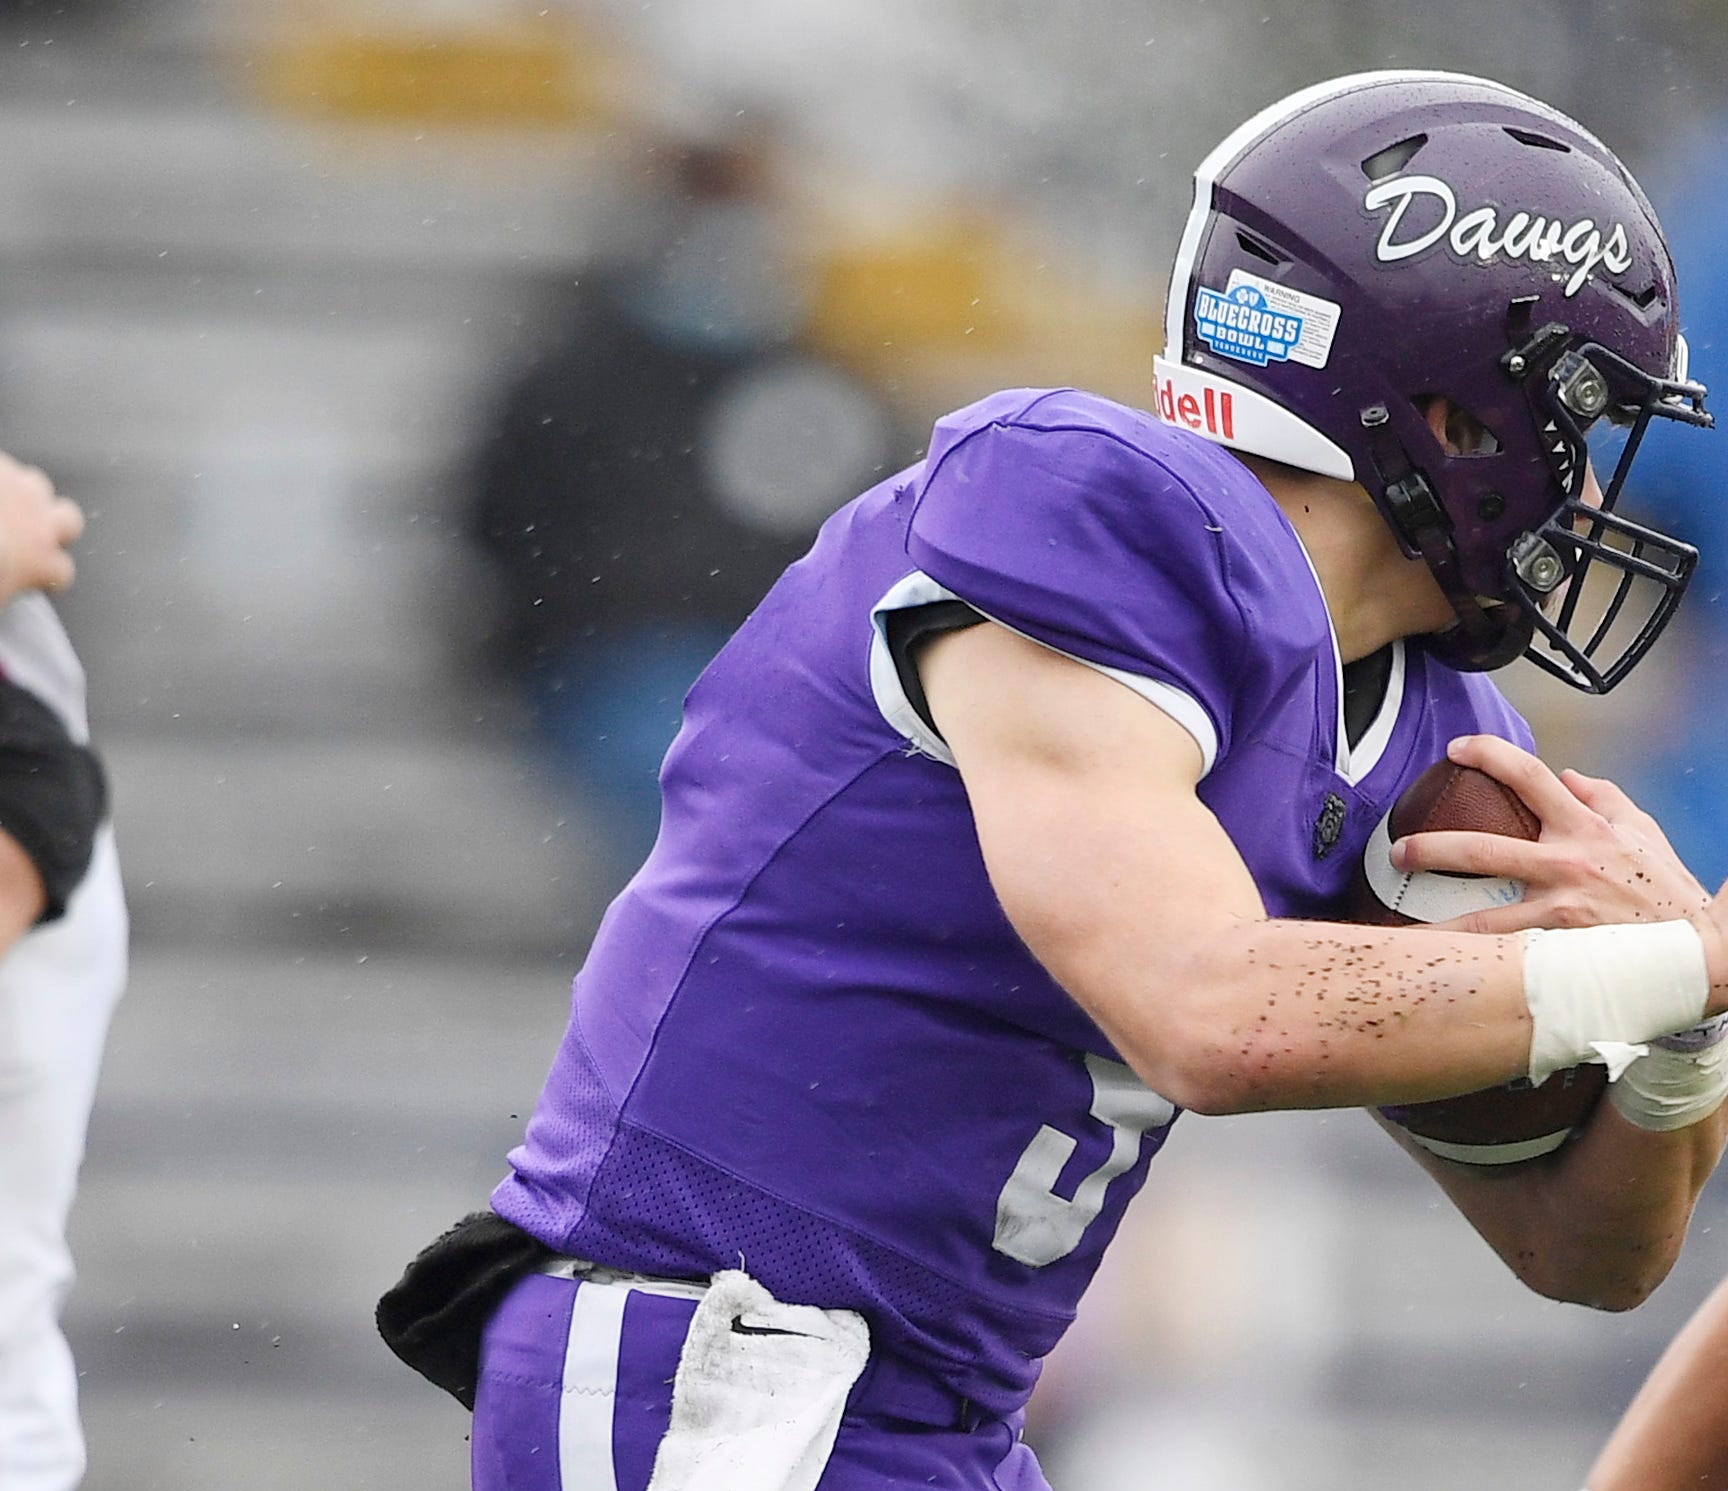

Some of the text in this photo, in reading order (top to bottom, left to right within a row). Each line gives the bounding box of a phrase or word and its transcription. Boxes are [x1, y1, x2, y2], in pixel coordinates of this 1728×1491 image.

[1365, 175, 1633, 298] Dawgs
[1199, 293, 1299, 343] BLUECROSS
[1215, 324, 1265, 350] BOWL
